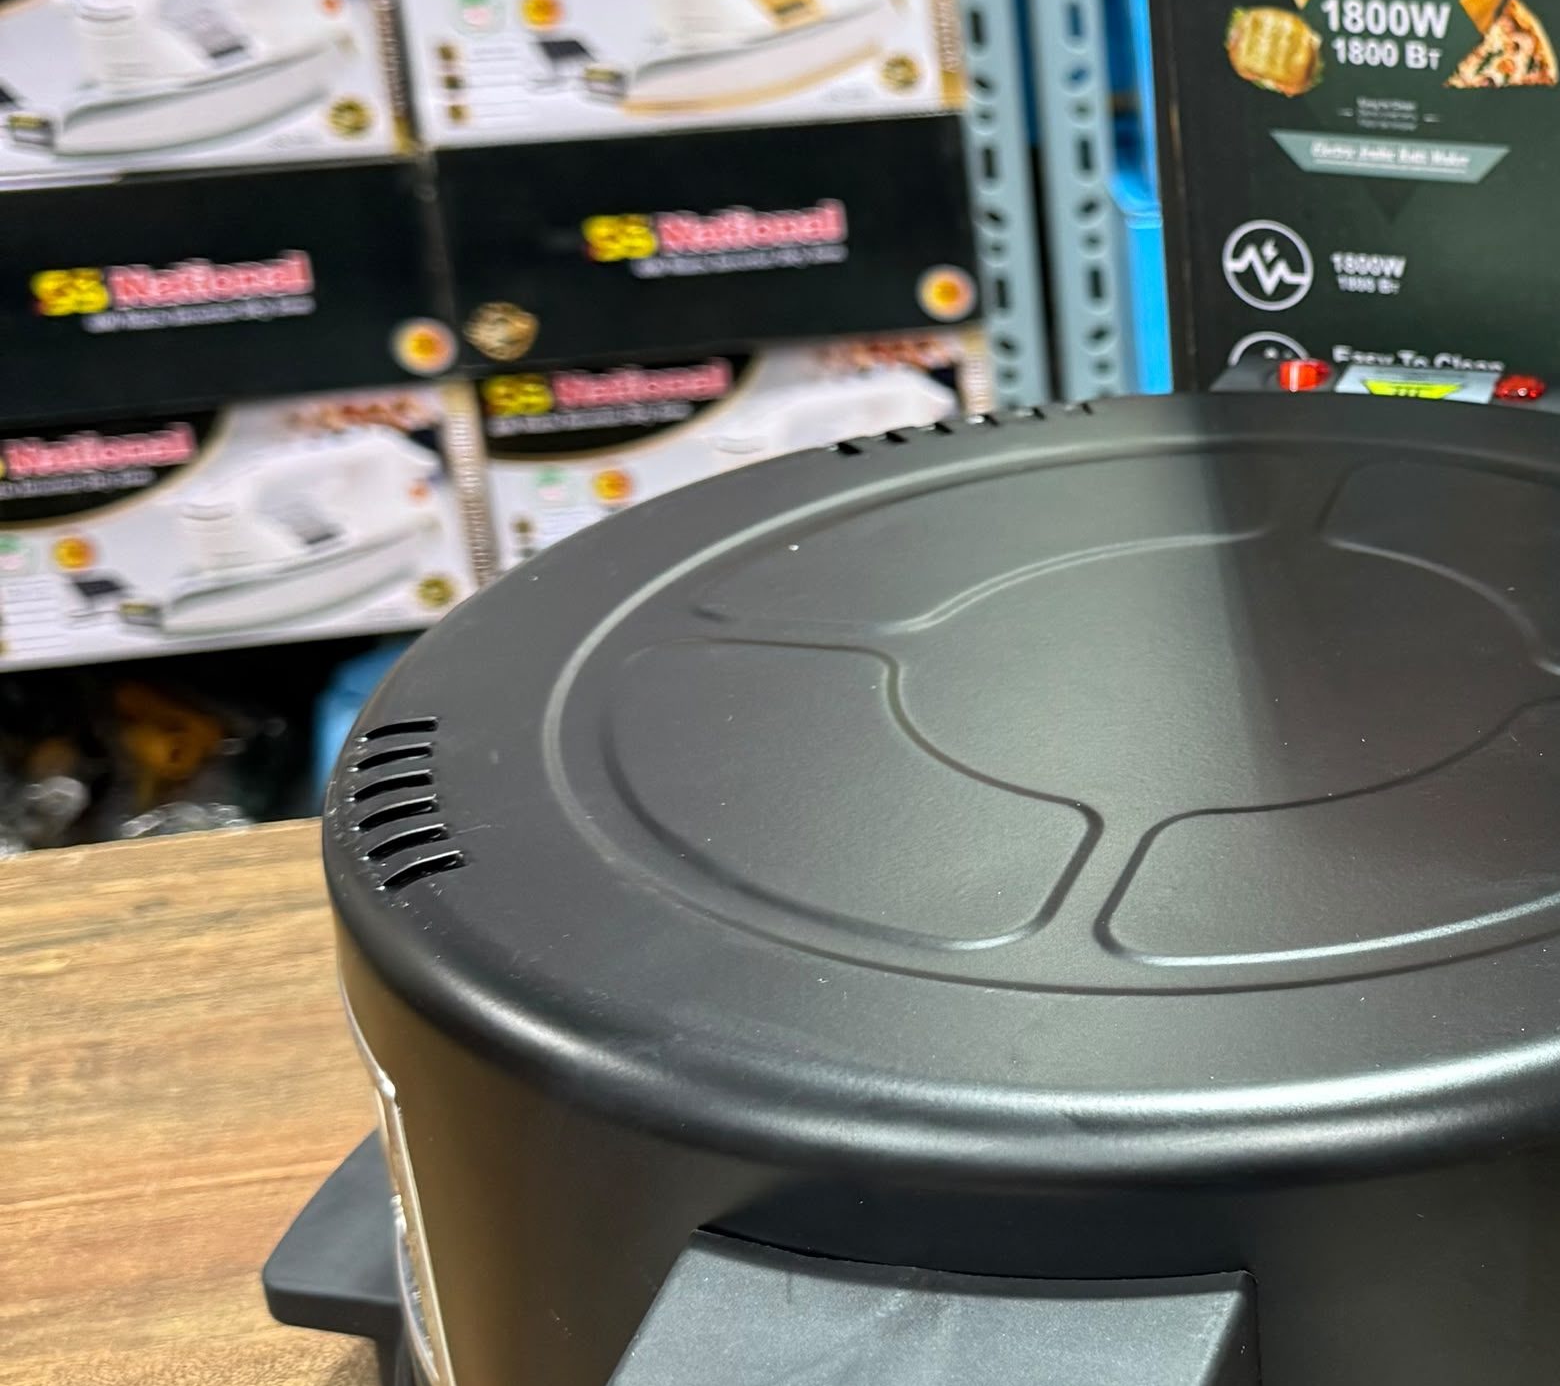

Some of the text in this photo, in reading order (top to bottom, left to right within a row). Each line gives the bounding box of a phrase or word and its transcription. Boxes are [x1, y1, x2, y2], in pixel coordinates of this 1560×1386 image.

[1331, 36, 1399, 67] 1800
[656, 198, 847, 256] National
[107, 249, 314, 311] National
[1330, 252, 1407, 278] 1800W
[550, 356, 733, 412] National
[4, 420, 196, 481] National
